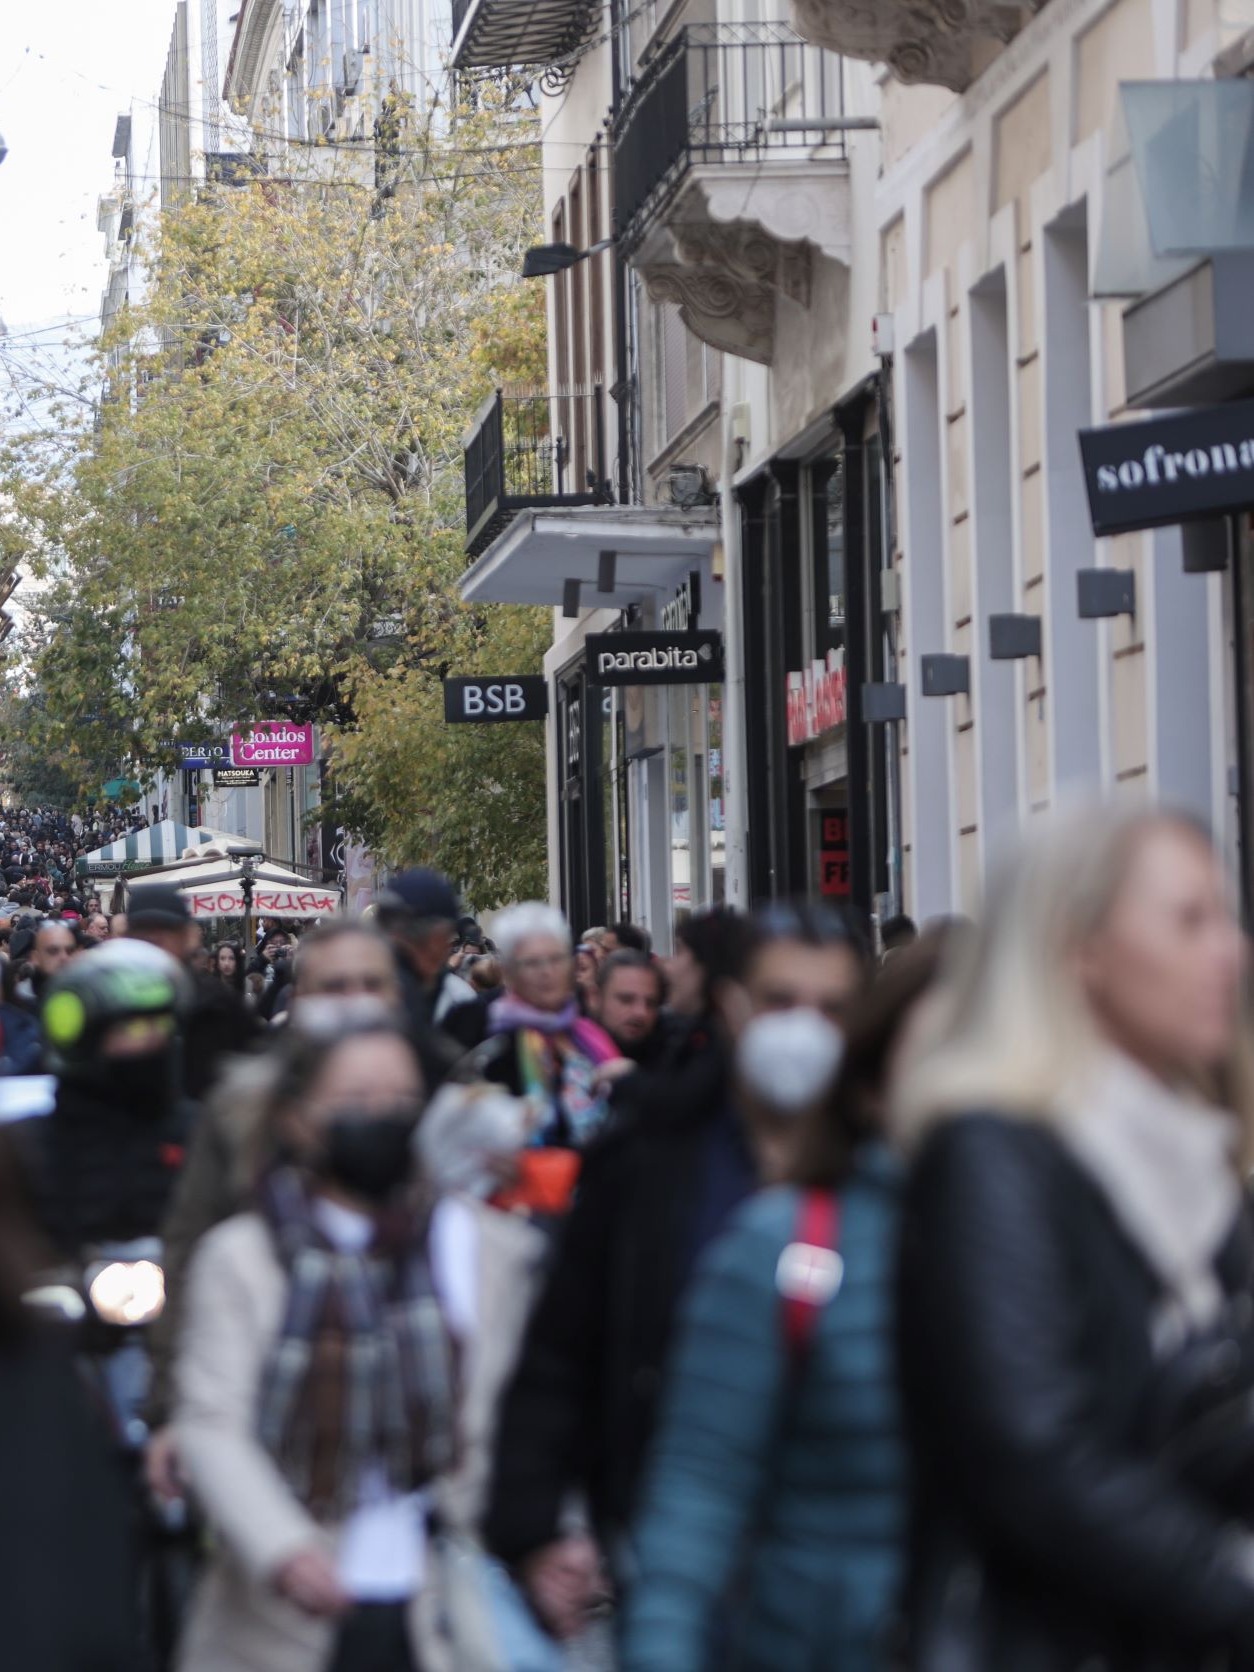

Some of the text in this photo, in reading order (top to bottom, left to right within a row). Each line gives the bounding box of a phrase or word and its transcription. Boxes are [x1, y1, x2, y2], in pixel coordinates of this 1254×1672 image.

[598, 645, 698, 674] parabita
[463, 683, 527, 715] BSB
[240, 743, 299, 761] Center
[88, 863, 121, 871] ERMOU
